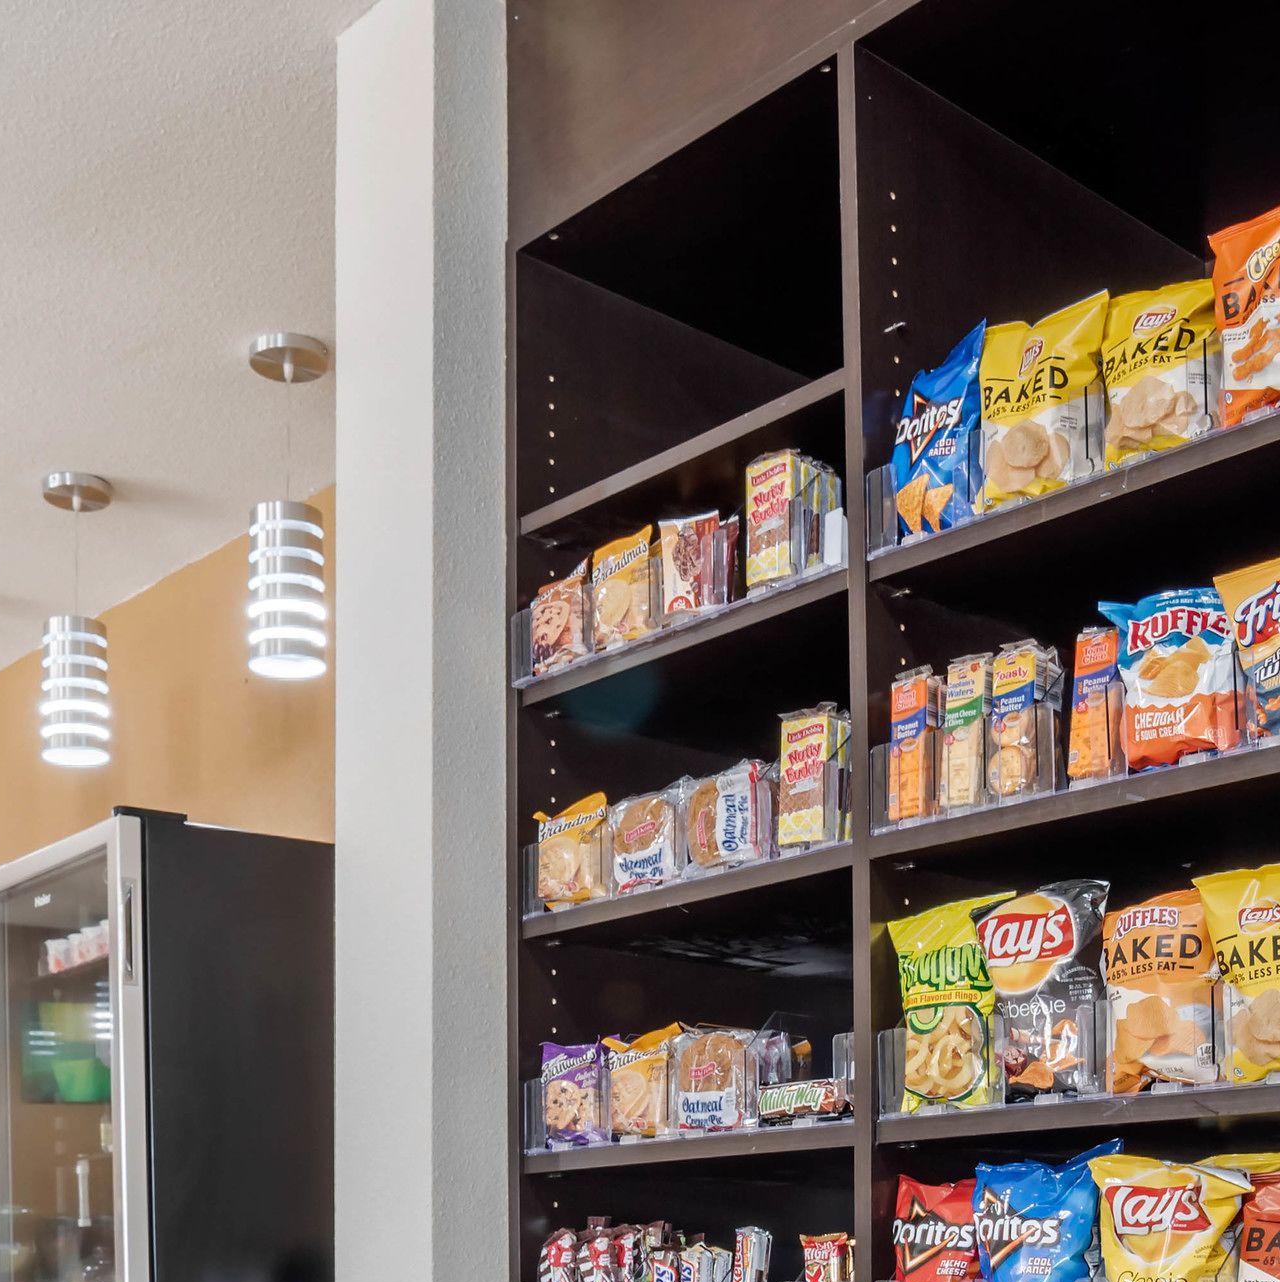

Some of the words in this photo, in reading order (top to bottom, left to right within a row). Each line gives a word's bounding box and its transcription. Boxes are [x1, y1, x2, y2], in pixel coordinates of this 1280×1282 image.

[1105, 327, 1196, 378] BAKED
[1129, 356, 1148, 372] LESS
[1153, 355, 1171, 363] FAT
[984, 366, 1068, 411] BAKED
[1010, 403, 1030, 413] LESS
[1031, 393, 1047, 405] FAT
[895, 395, 963, 445] Doritos
[928, 447, 957, 456] RANCH
[752, 481, 786, 507] Nutty
[995, 666, 1028, 684] Toasty
[1083, 675, 1110, 686] Peanut
[1000, 695, 1025, 707] Peanut
[897, 720, 919, 731] Peanut
[1134, 706, 1186, 730] CHEDDAR
[788, 742, 823, 766] Nutty
[785, 760, 825, 785] Buddy
[721, 793, 739, 852] Oatmeal
[1113, 907, 1179, 941] RUFFLES
[982, 910, 1067, 968] Lay's
[1111, 967, 1128, 981] 65%
[1131, 962, 1154, 976] LESS
[1157, 961, 1178, 971] FAT
[1248, 967, 1272, 981] LESS
[920, 991, 953, 1003] Flavored
[954, 990, 978, 1004] Rings
[682, 1095, 724, 1114] Oatmeal
[760, 1086, 795, 1114] Milky
[794, 1082, 825, 1111] Way
[1112, 1185, 1202, 1236] Lay's
[893, 1219, 976, 1249] Doritos
[939, 1259, 968, 1269] NACHO
[1020, 1265, 1053, 1275] RANCH
[1028, 1257, 1053, 1266] COOL
[936, 1268, 968, 1277] CHEESE
